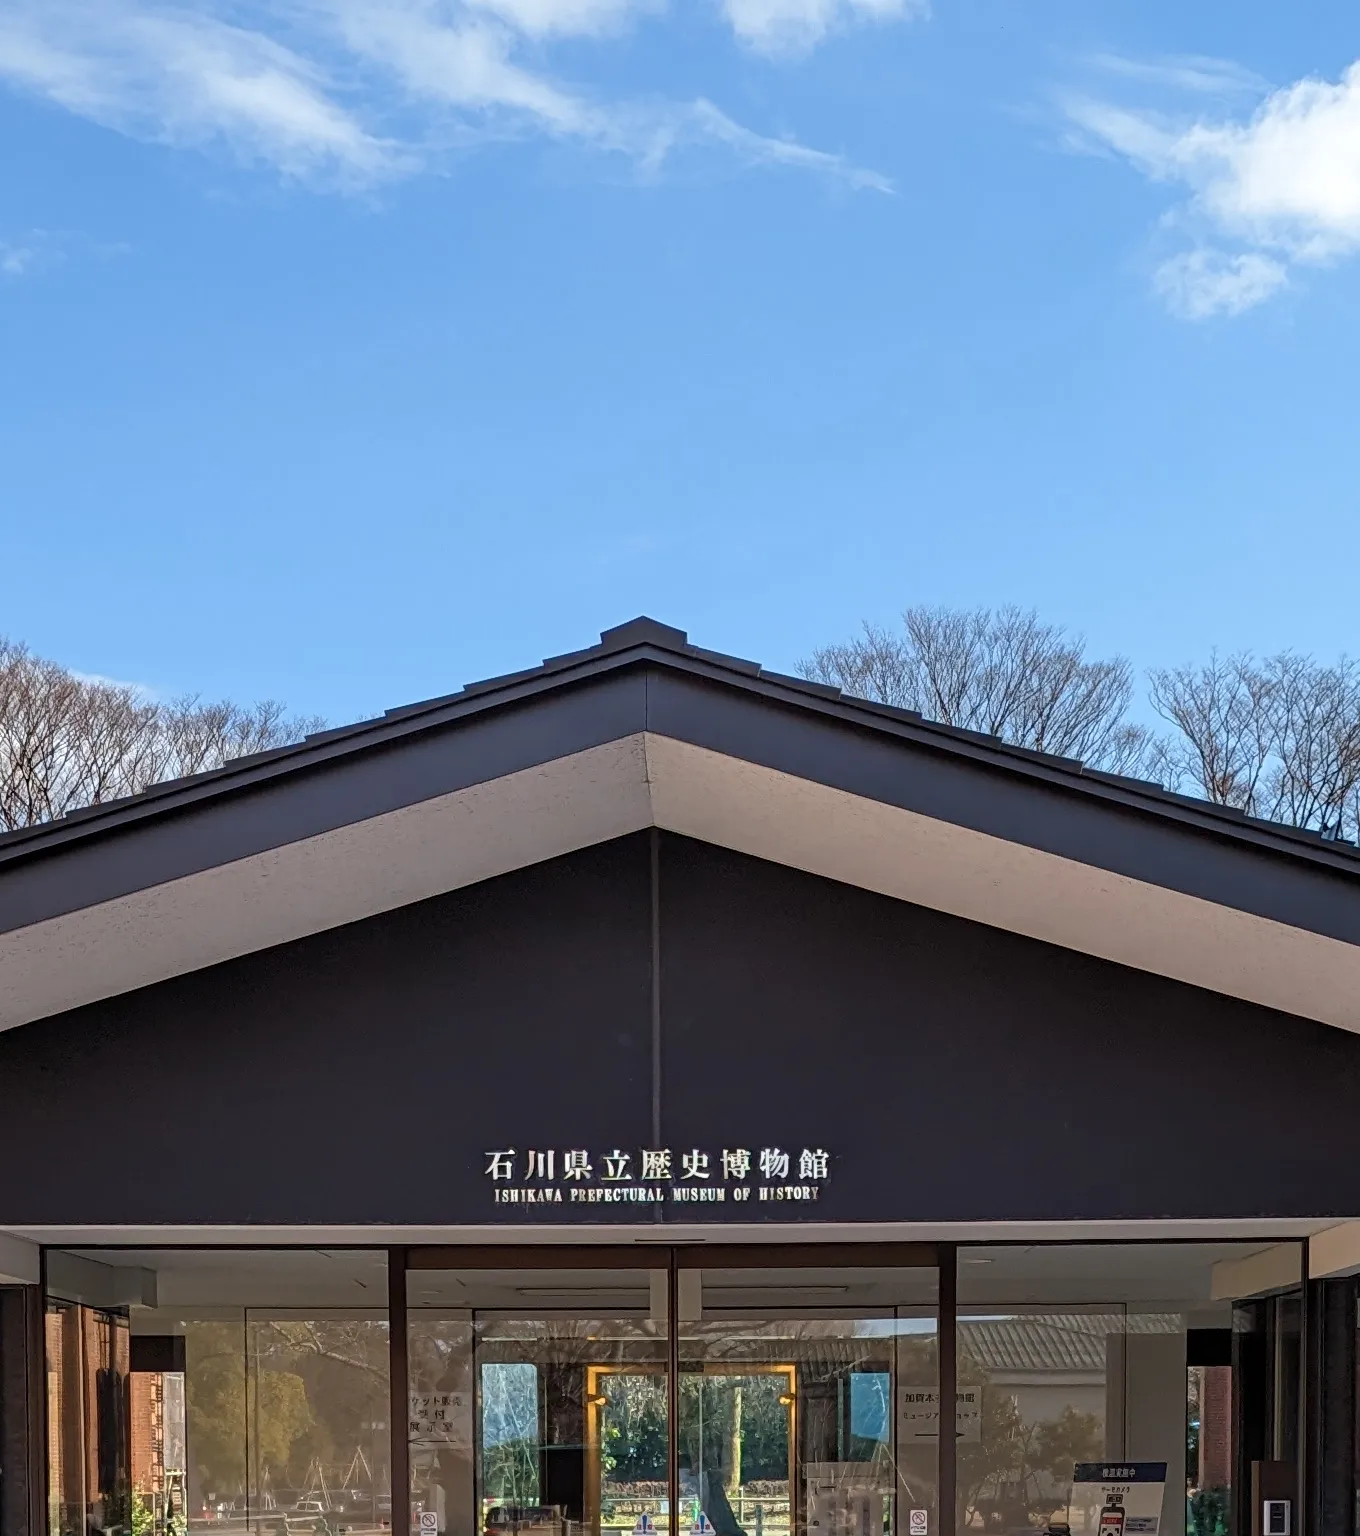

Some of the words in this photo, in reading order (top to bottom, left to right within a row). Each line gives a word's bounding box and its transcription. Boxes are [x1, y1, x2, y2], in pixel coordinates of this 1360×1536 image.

[484, 1148, 830, 1181] 石川県立歴史博物館
[494, 1188, 563, 1203] ISHIKAWA
[570, 1188, 664, 1202] PREFECTURAL
[673, 1188, 726, 1202] MUSEUM
[733, 1187, 751, 1201] OF
[759, 1186, 820, 1201] HISTORY
